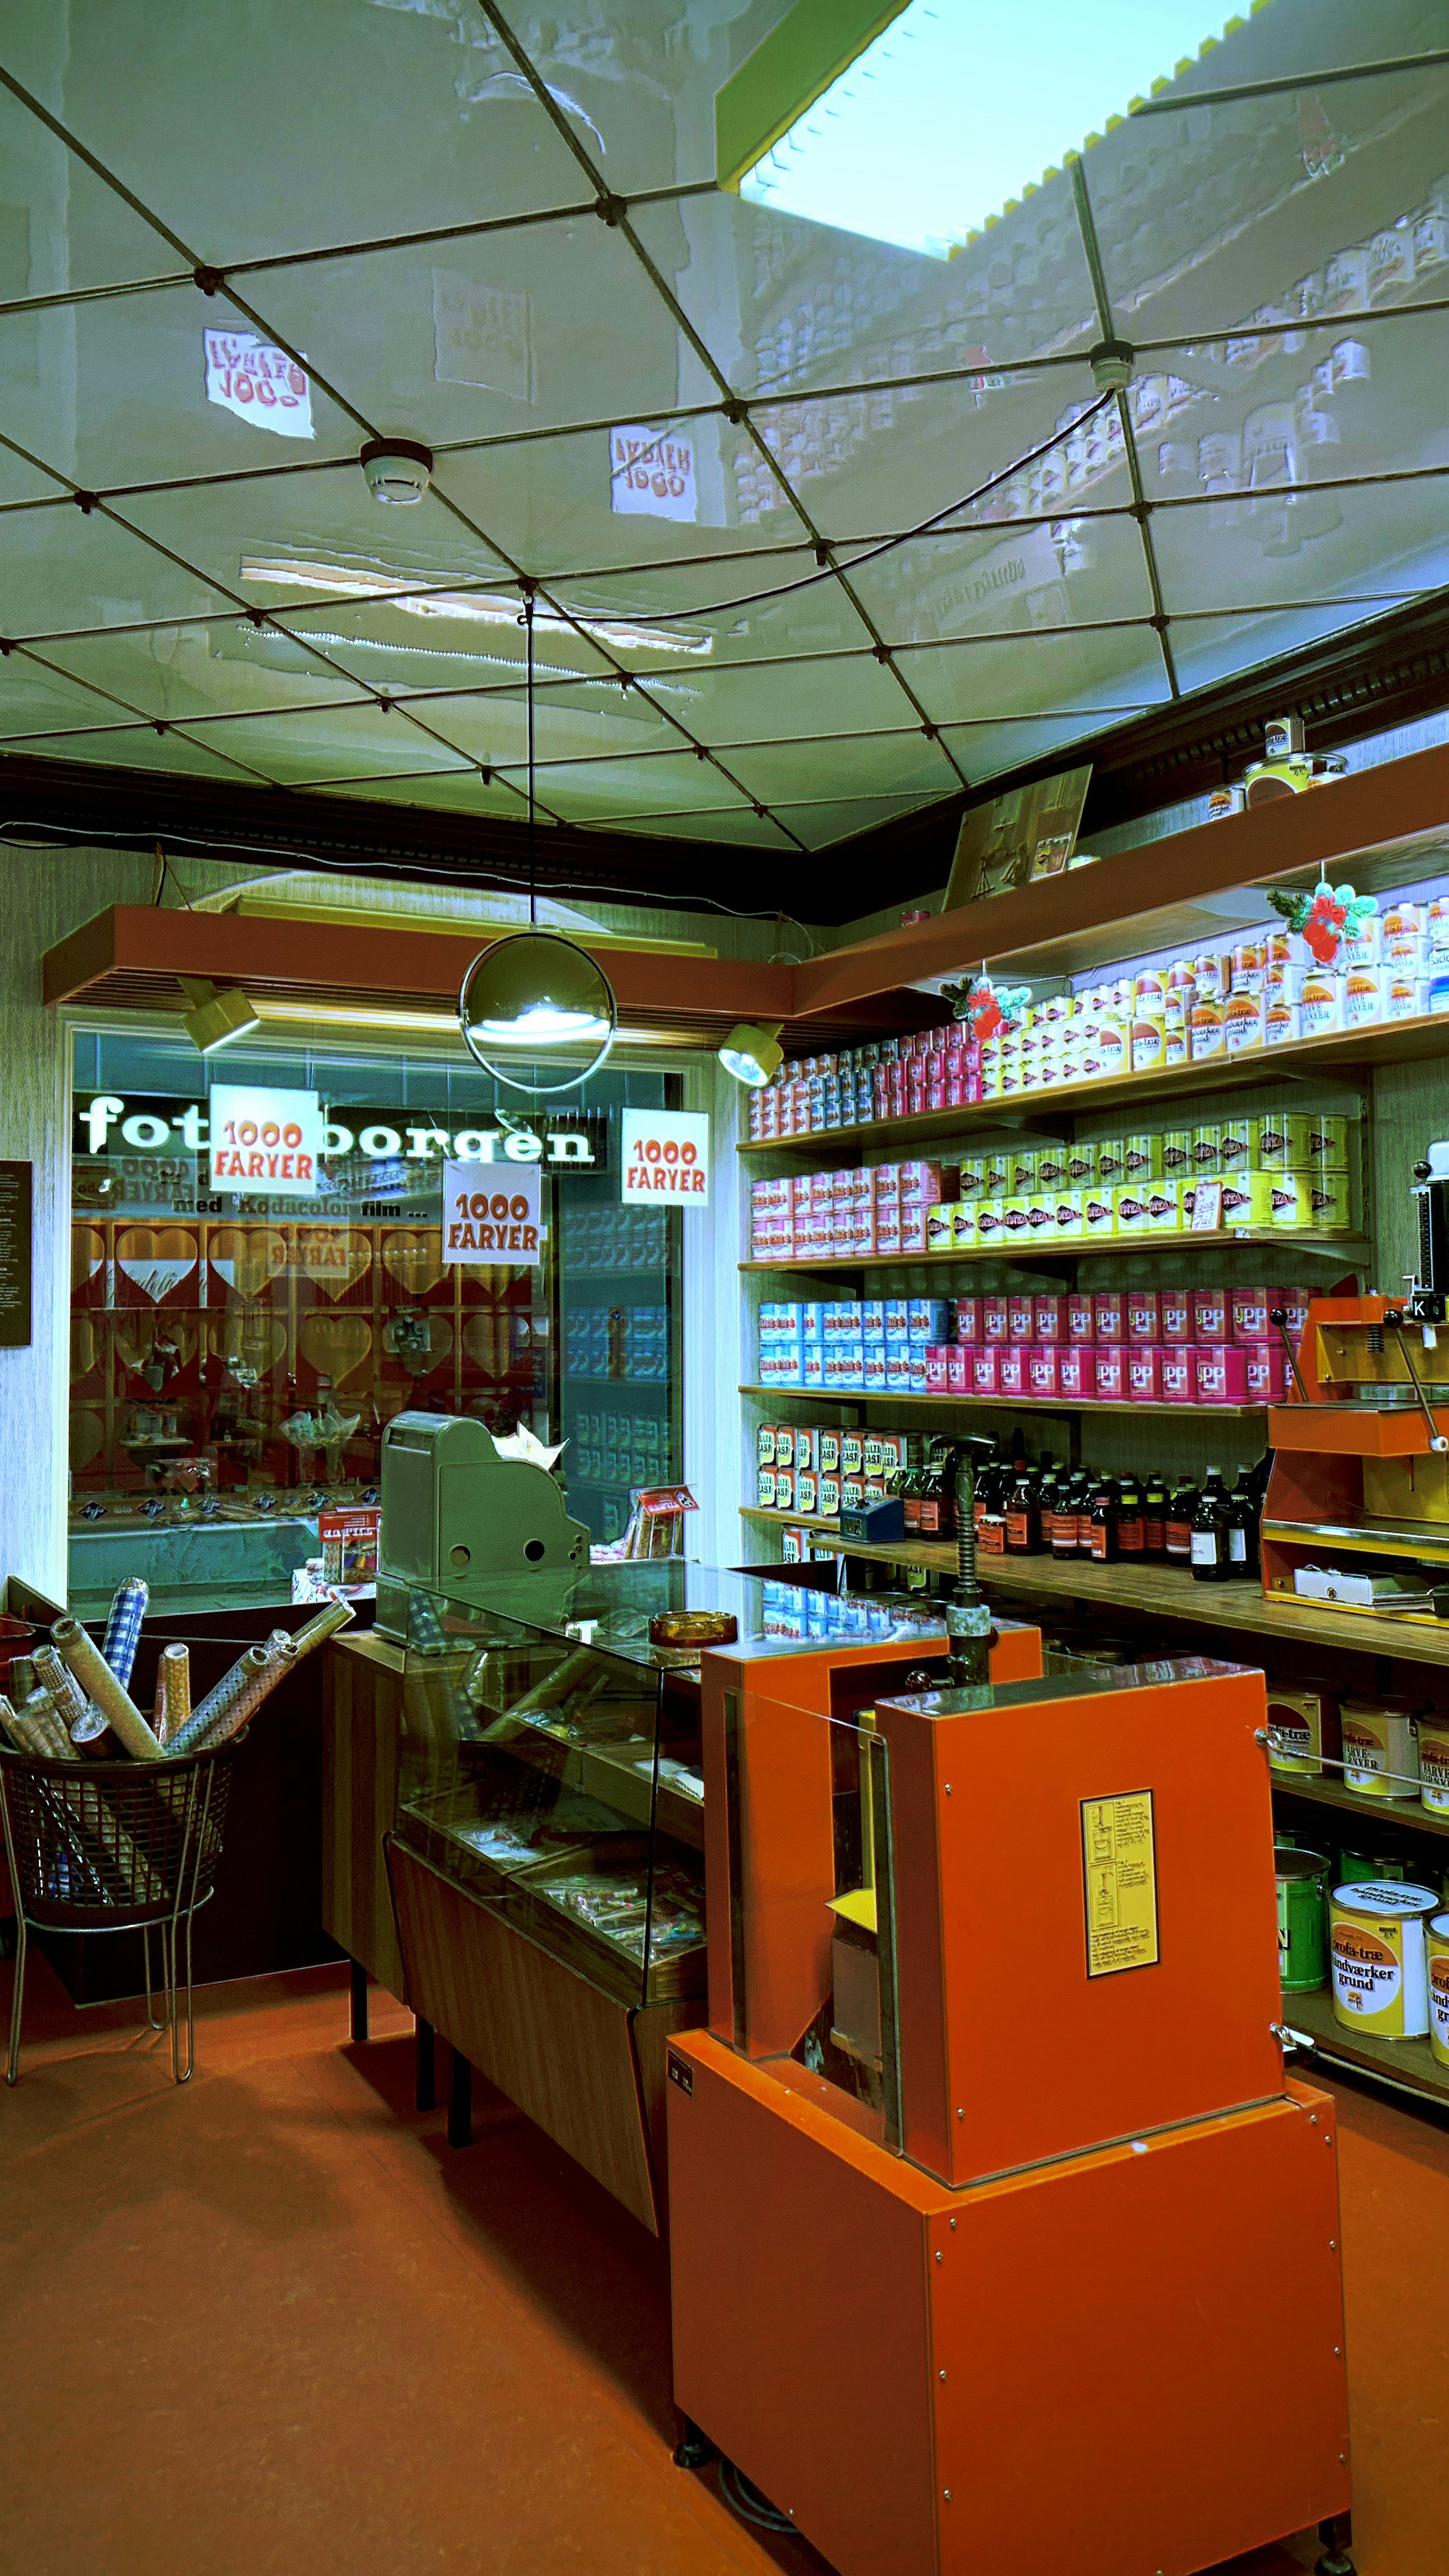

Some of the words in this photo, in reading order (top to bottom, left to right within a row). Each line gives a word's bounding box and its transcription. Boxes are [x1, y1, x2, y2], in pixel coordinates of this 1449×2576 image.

[79, 1096, 209, 1154] fot
[224, 1119, 303, 1149] 1000
[632, 1139, 698, 1166] 1000
[174, 1196, 222, 1213] med
[362, 1200, 401, 1217] film
[456, 1193, 530, 1222] 1000
[1414, 1301, 1425, 1315] K
[1338, 1972, 1374, 1991] grund
